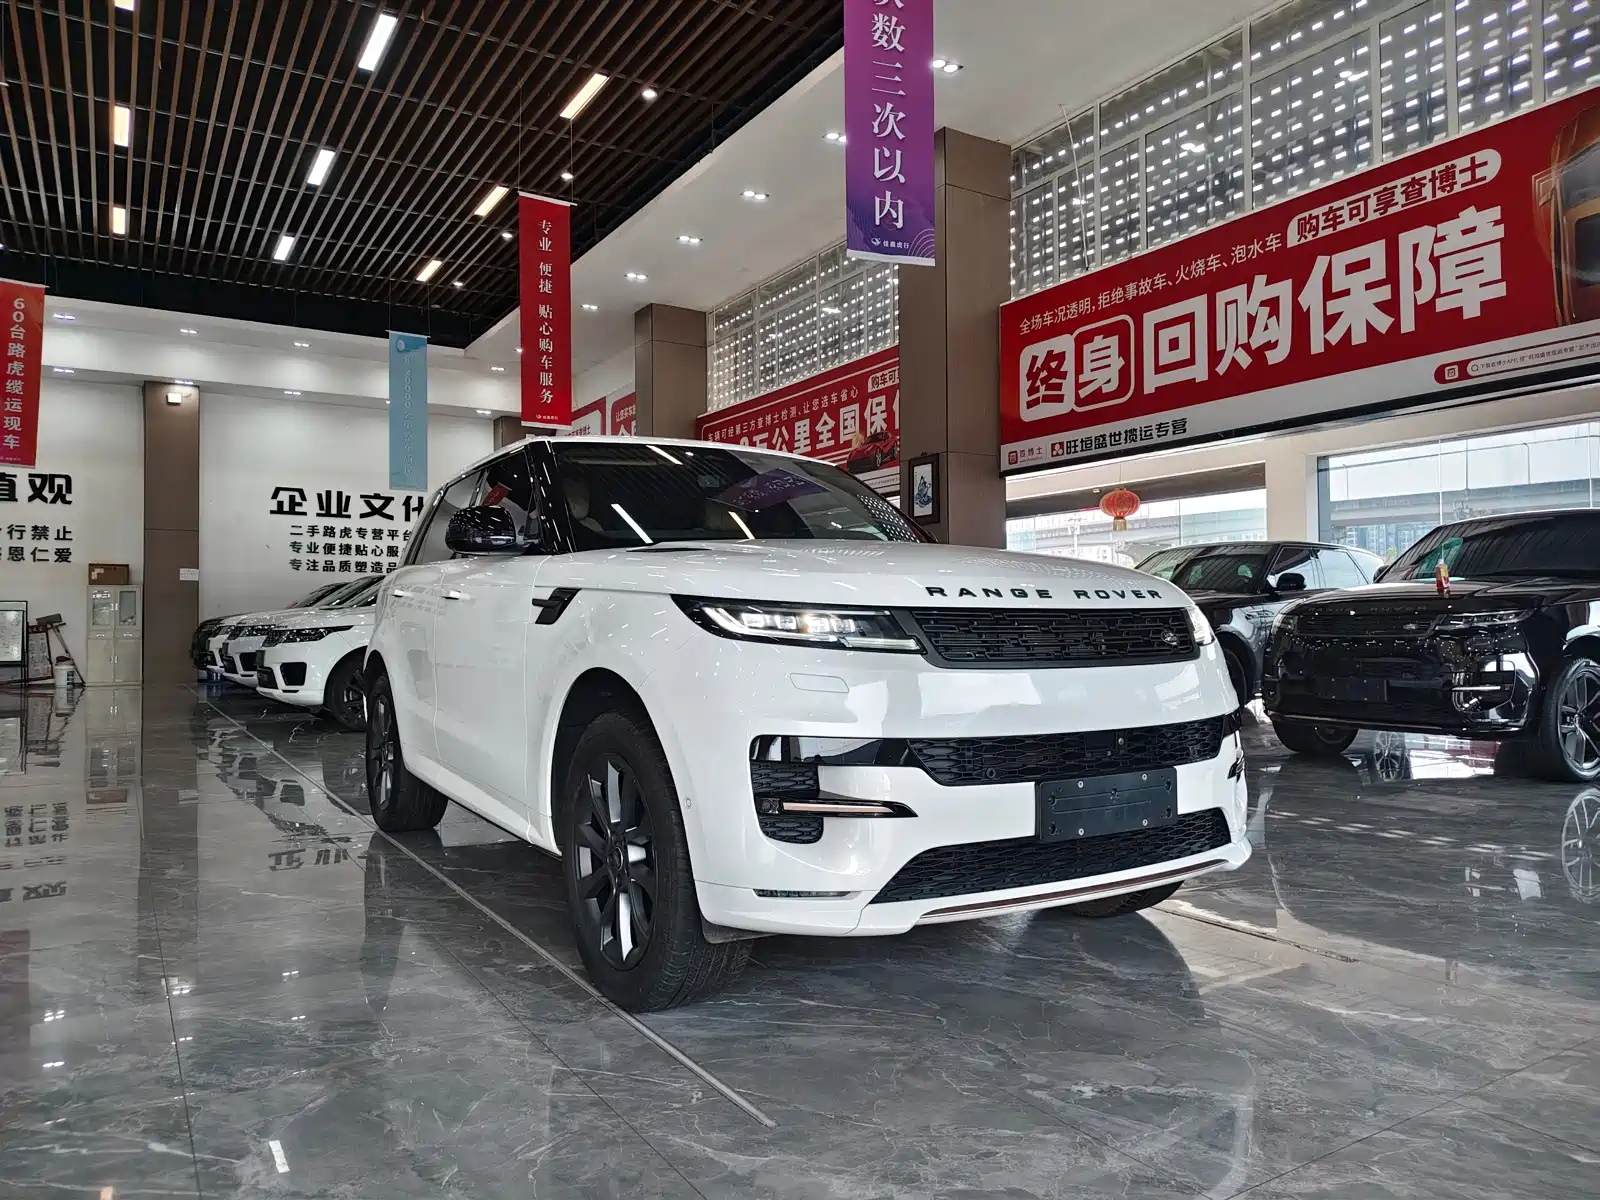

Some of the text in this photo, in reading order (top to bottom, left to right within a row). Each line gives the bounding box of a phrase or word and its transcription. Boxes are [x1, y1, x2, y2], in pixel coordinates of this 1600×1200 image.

[871, 0, 906, 229] 数三次以内
[1296, 155, 1489, 243] 购车可享查博士
[538, 219, 553, 252] 专业
[538, 262, 553, 294] 便捷
[1023, 204, 1507, 412] 终身回购保障
[538, 304, 553, 404] 贴心购车服务
[1065, 417, 1188, 456] 旺垣盛世揽运专营
[0, 524, 73, 541] 行禁止
[289, 525, 412, 542] 二手路虎专营平台
[0, 546, 72, 563] 恩仁爱
[289, 541, 405, 558] 专业便捷贴心服
[924, 586, 1163, 600] RANGE ROVER
